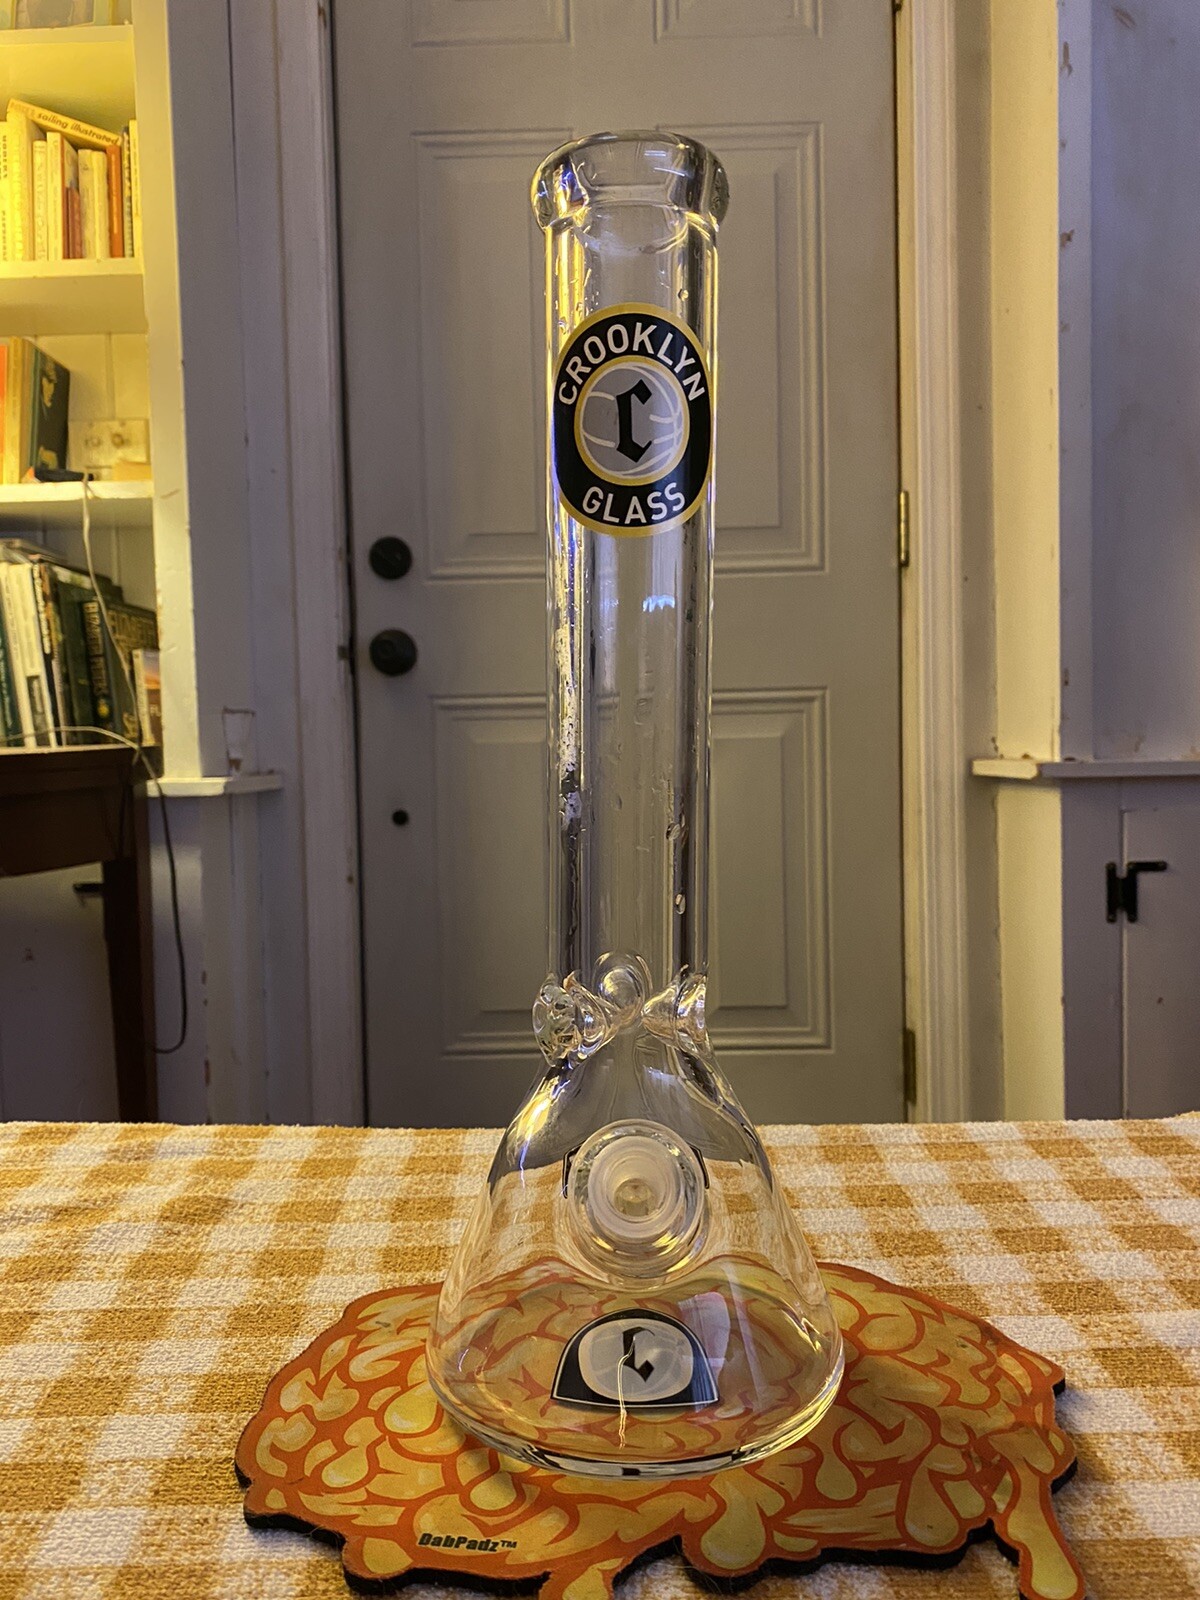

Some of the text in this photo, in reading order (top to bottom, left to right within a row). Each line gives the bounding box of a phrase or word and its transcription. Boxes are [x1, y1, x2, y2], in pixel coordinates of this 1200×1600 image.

[37, 112, 121, 145] sailing illustrated
[558, 321, 706, 406] CROOKLYN
[581, 481, 686, 525] GLASS
